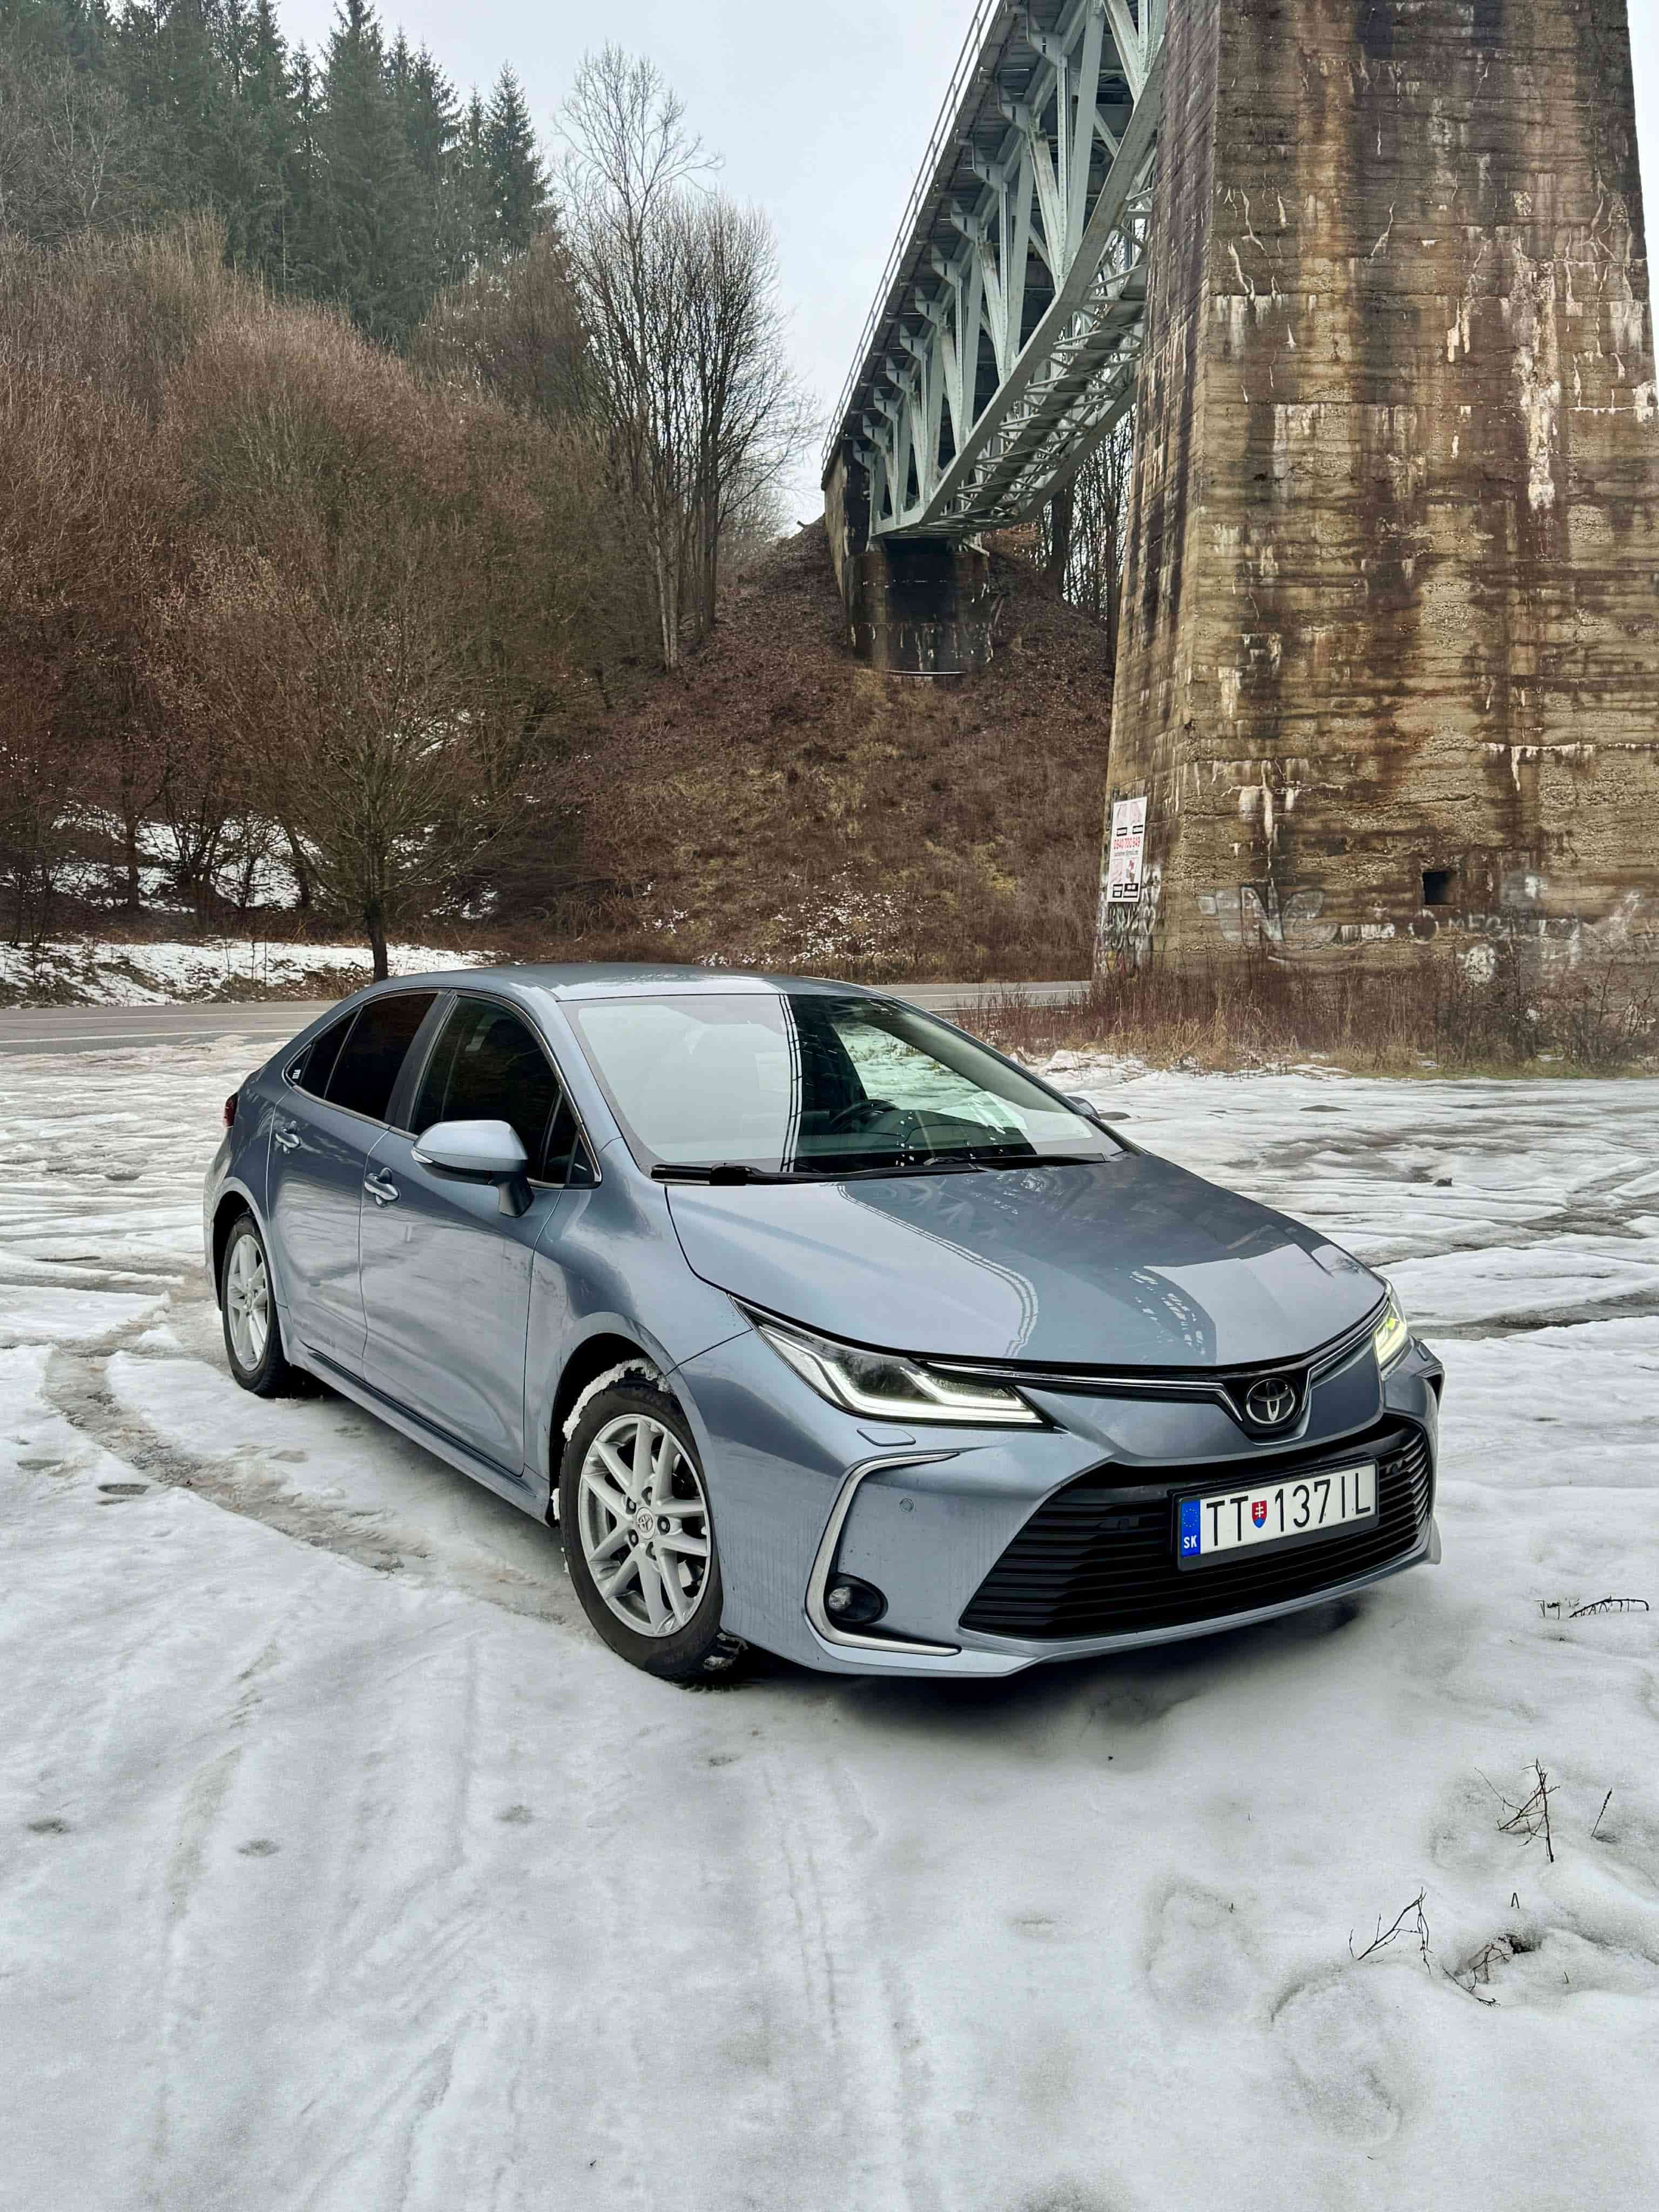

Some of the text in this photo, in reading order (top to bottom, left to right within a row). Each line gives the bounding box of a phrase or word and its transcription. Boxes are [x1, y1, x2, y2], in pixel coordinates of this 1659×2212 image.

[1206, 1473, 1371, 1546] TT 137IL
[1183, 1535, 1197, 1549] SK
